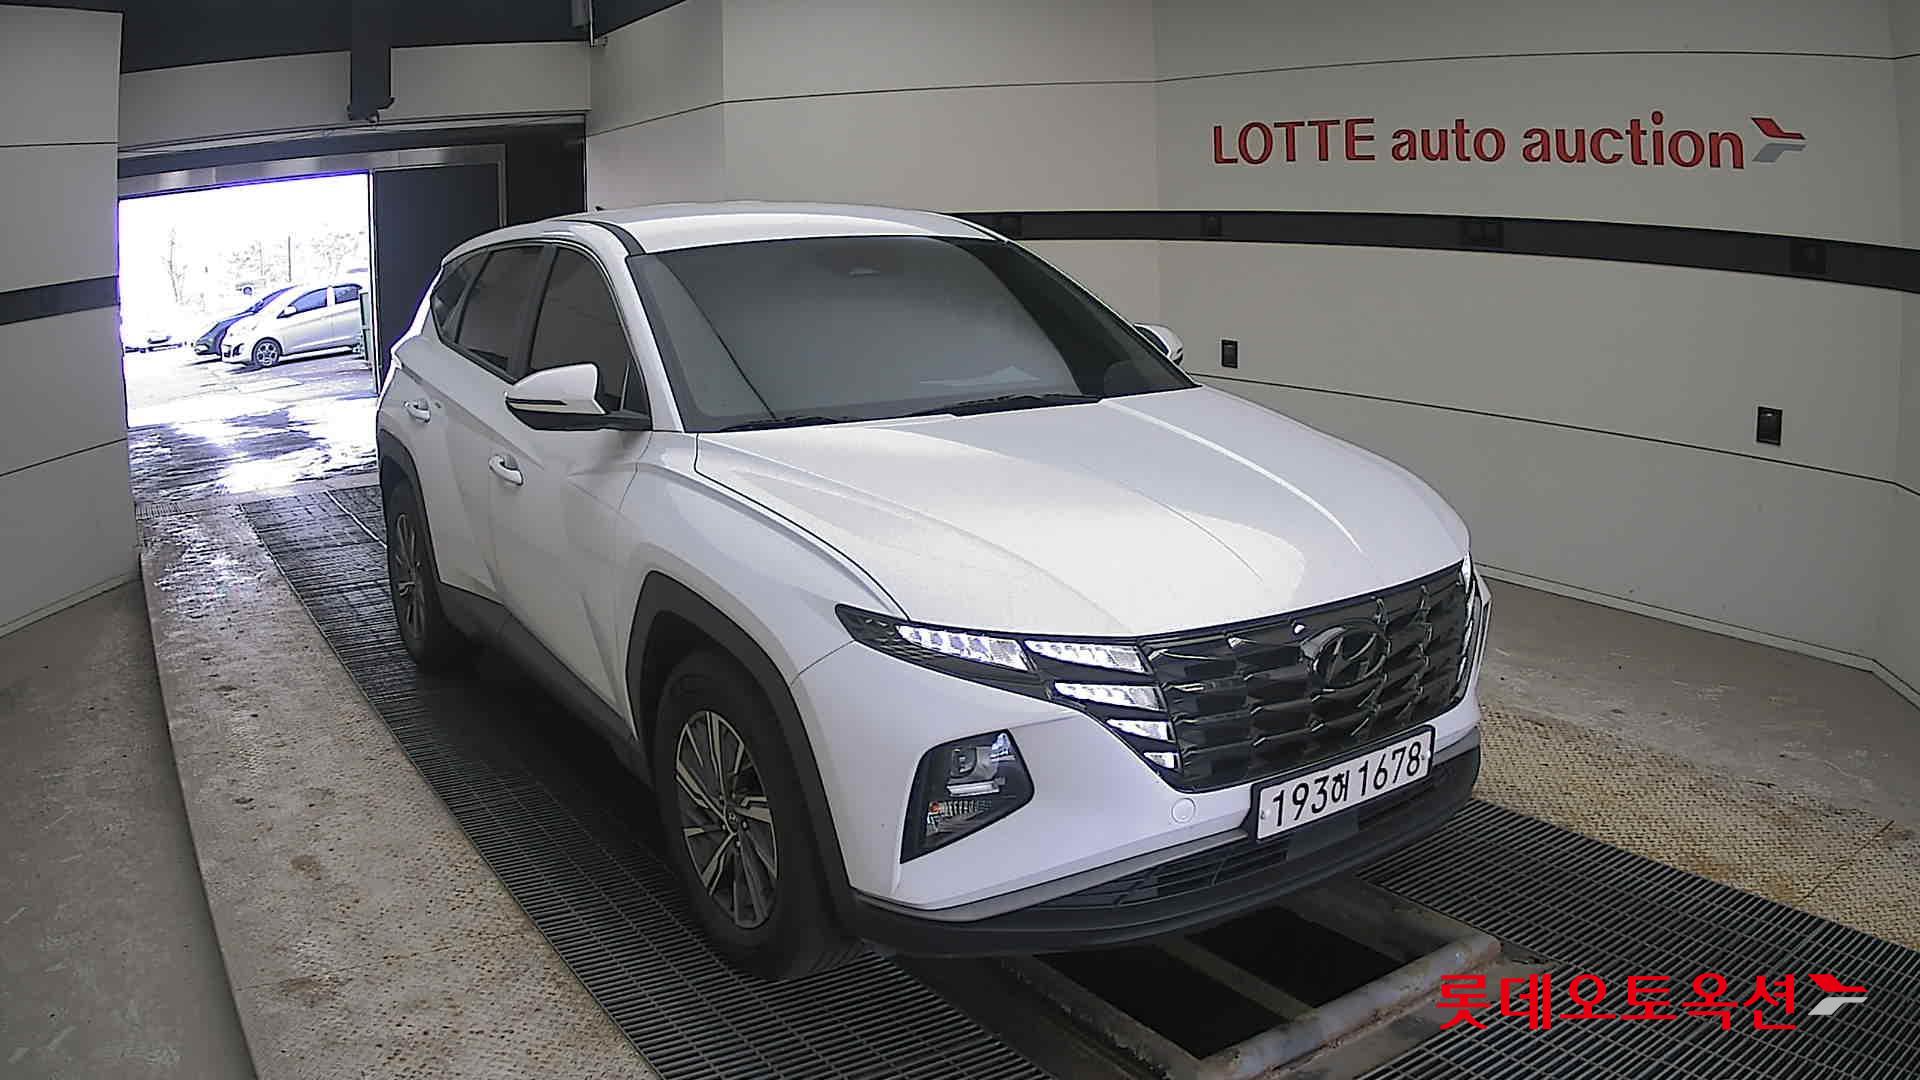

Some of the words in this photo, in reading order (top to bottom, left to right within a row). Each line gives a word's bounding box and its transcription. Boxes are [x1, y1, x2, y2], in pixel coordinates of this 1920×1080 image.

[1213, 117, 1376, 165] LOTTE
[1391, 118, 1506, 162] auto
[1523, 111, 1745, 169] auction
[1272, 770, 1350, 827] 193허
[1358, 741, 1422, 797] 1678
